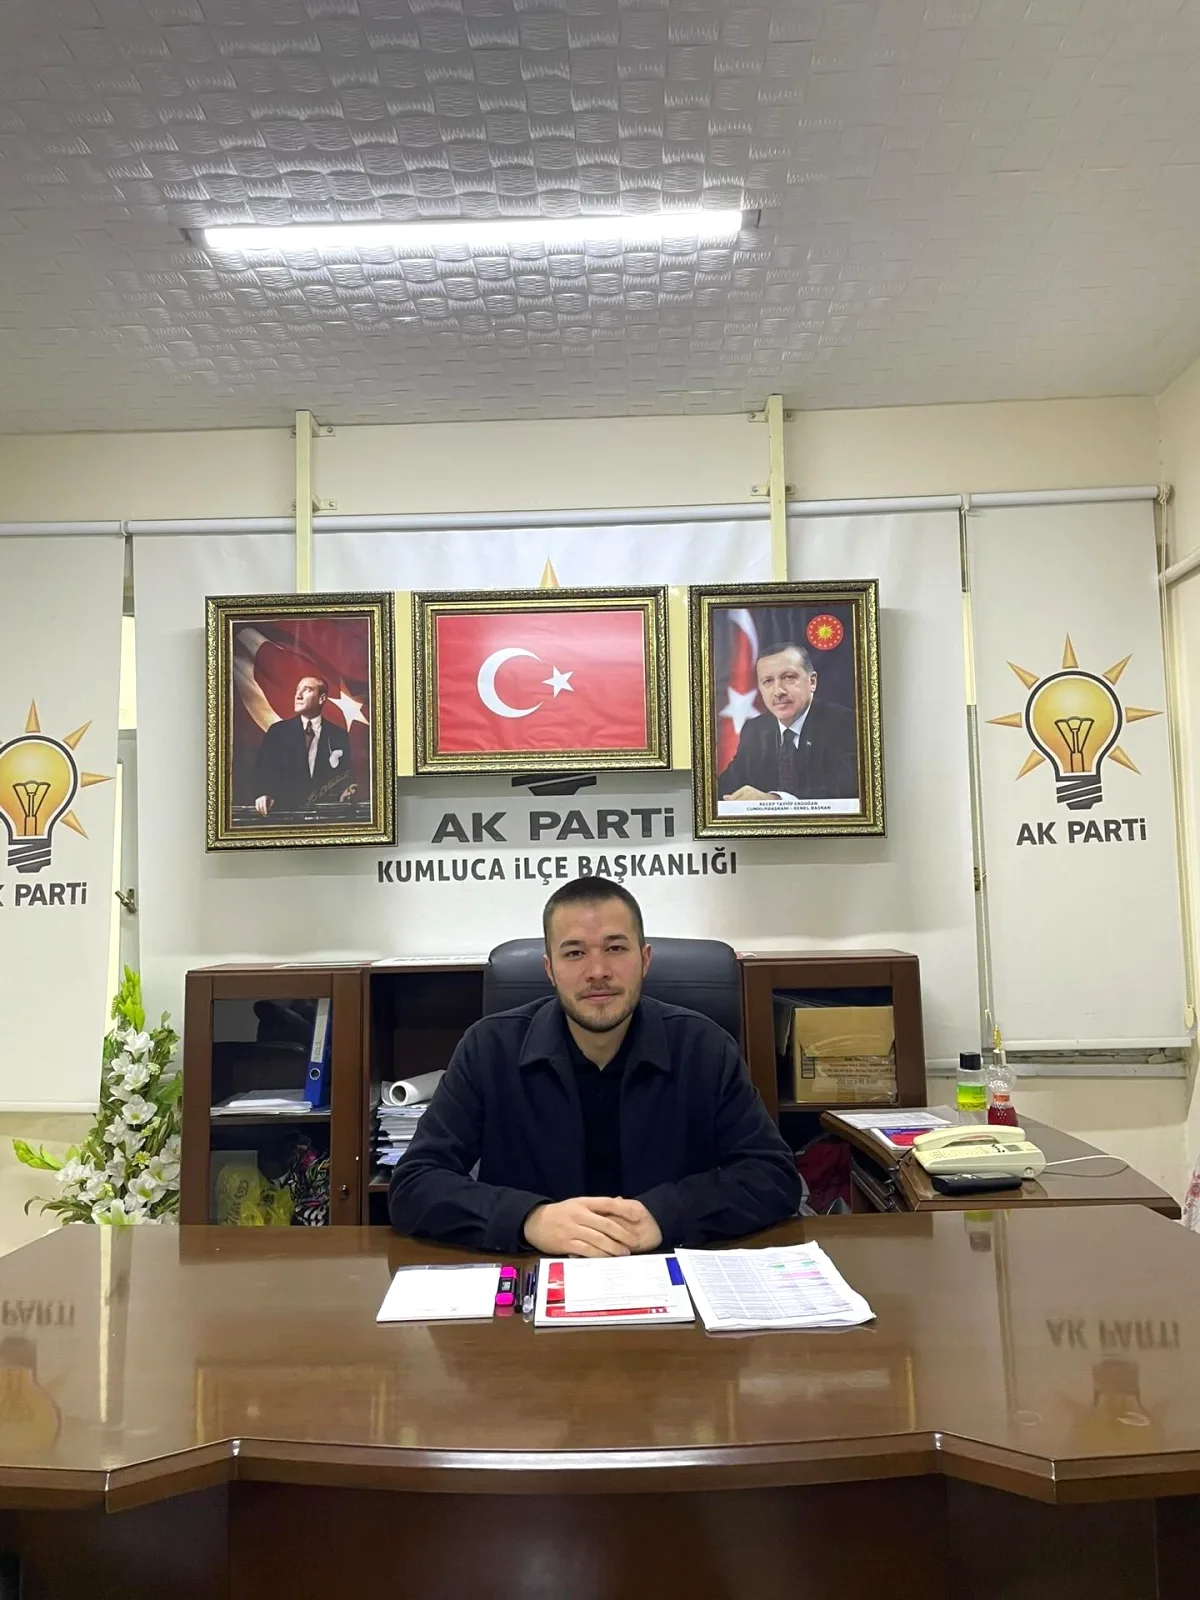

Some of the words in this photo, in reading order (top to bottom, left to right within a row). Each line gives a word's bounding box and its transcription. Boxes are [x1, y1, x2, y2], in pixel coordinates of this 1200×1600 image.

[431, 812, 507, 843] AK
[1016, 822, 1057, 846] AK
[377, 858, 506, 883] KUMLUCA
[578, 847, 737, 885] BAŞKANLIĞI
